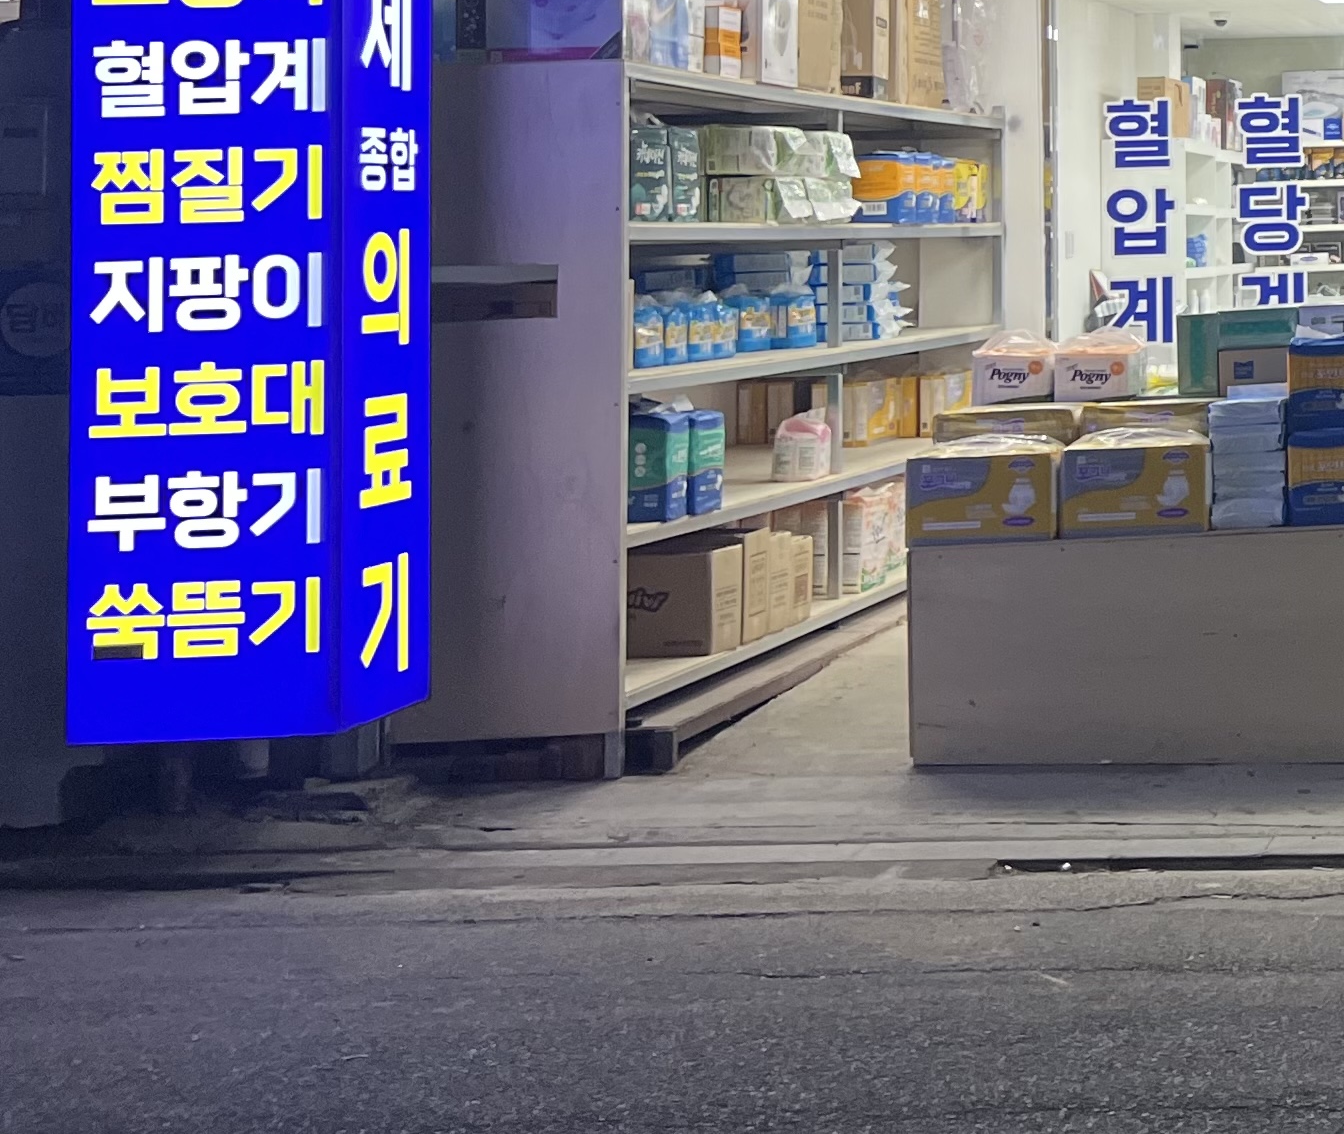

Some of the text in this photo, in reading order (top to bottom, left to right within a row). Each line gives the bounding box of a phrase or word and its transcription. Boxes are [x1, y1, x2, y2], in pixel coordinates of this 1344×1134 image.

[92, 37, 327, 118] 혈압계
[90, 143, 326, 225] 찜질기
[1105, 98, 1176, 344] 혈압계
[90, 252, 325, 333] 지팡이
[88, 358, 326, 439] 보호대
[989, 368, 1030, 383] Pogny
[1070, 369, 1112, 384] Pogny
[87, 469, 324, 551] 부항기
[86, 576, 321, 660] 쑥뜸기
